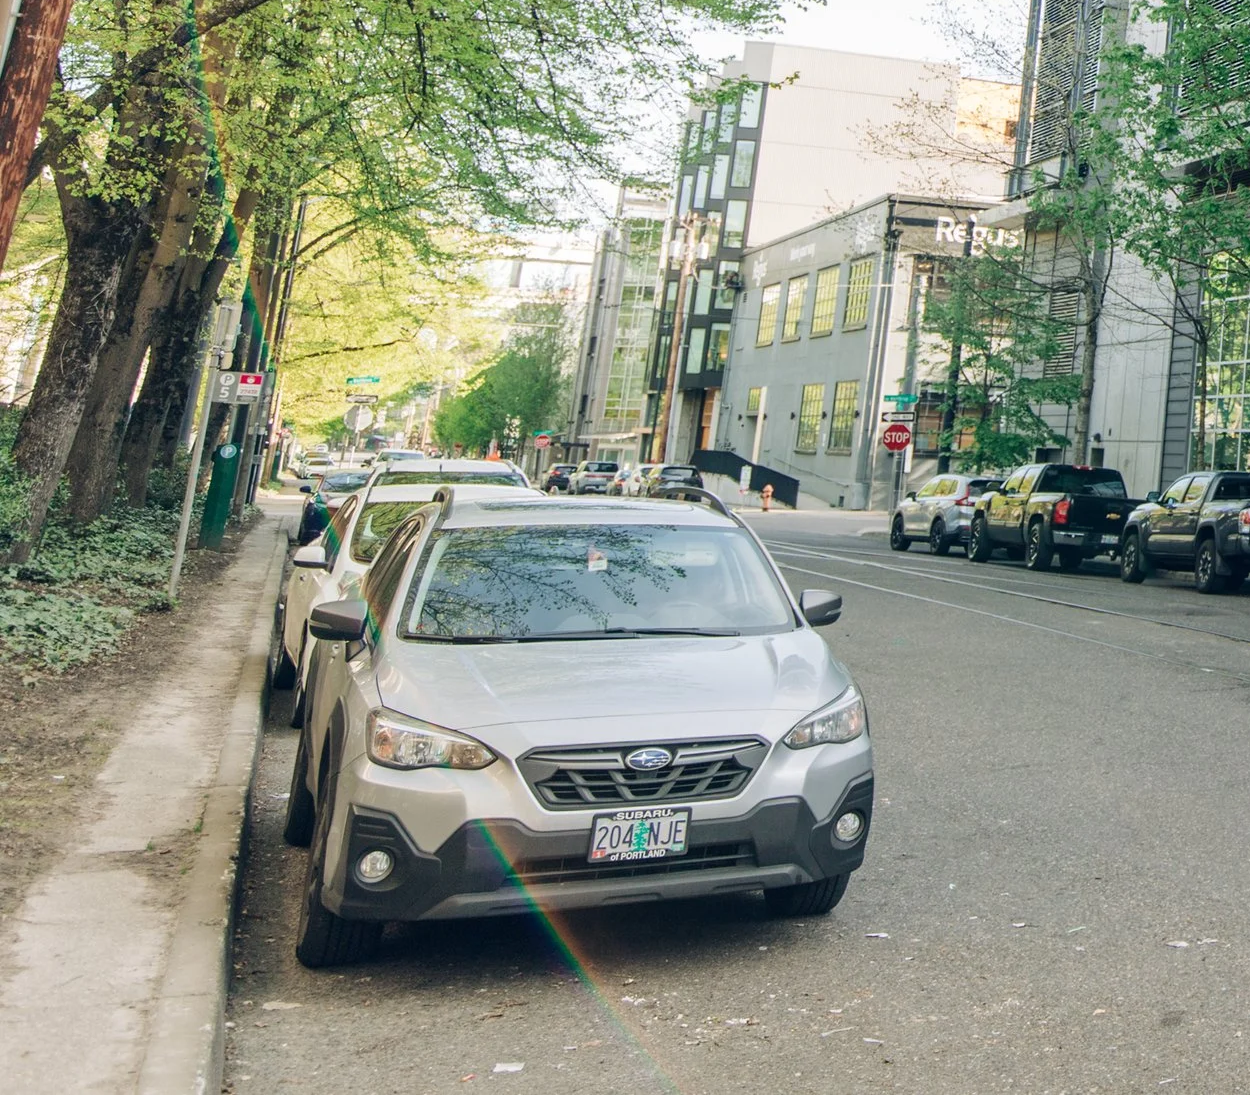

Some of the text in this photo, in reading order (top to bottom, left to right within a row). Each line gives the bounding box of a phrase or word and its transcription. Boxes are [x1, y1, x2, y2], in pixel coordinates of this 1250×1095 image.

[935, 215, 1019, 256] Regus
[219, 386, 230, 398] 5
[884, 432, 910, 444] STOP
[616, 809, 671, 820] SUBARU
[596, 820, 686, 850] 204 NJE
[610, 849, 666, 862] of PORTLAND
